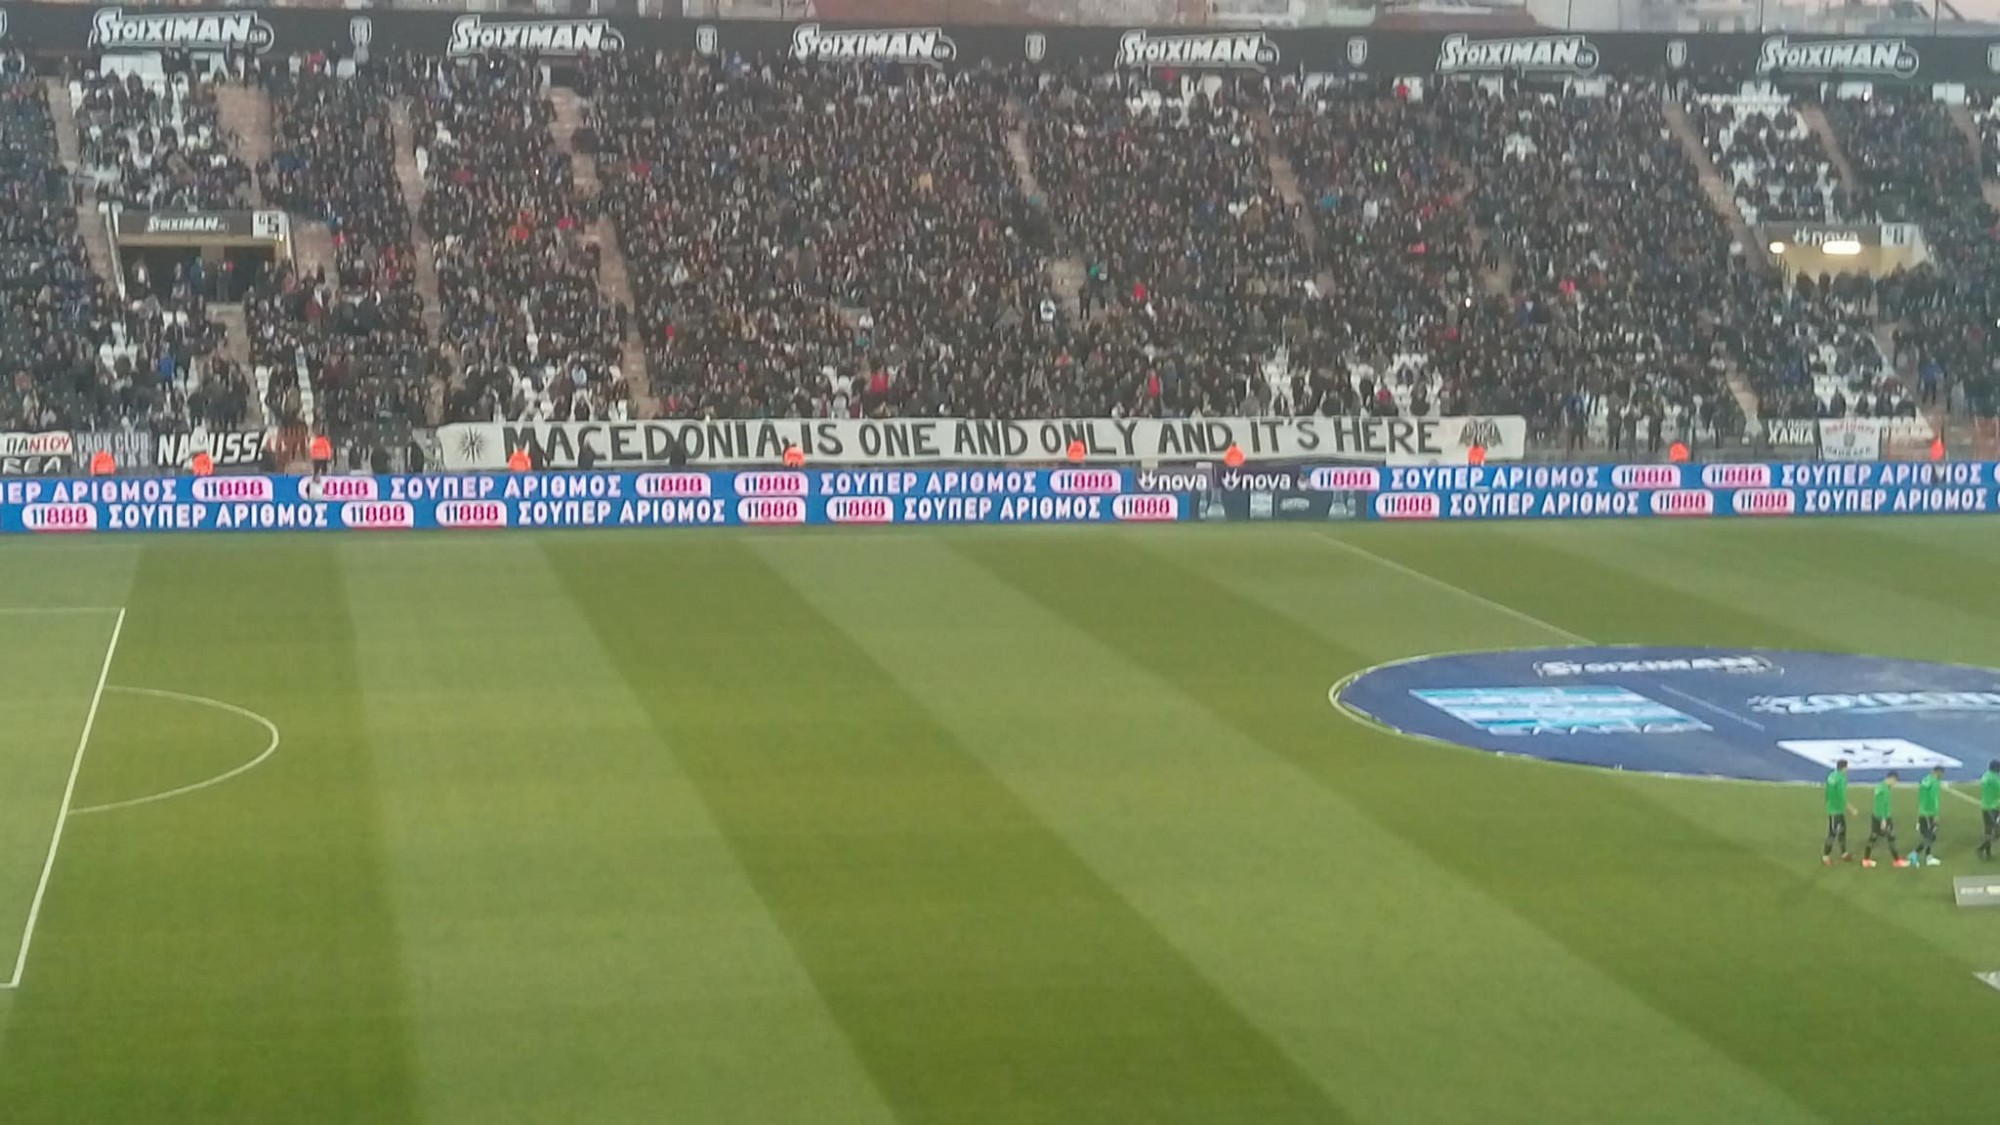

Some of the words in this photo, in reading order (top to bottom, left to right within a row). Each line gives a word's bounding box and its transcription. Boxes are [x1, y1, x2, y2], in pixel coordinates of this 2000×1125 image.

[502, 421, 782, 461] MACEDONIA
[801, 421, 843, 456] IS
[859, 422, 941, 457] ONE
[953, 419, 1029, 456] AND
[1040, 419, 1139, 455] ONLY
[1158, 419, 1234, 455] AND
[1250, 418, 1320, 454] IT'S
[1333, 416, 1443, 455] HERE
[391, 477, 494, 499] ΣΟΥΠΕΡ
[503, 474, 622, 498] ΑΡΙΘΜΟΣ
[644, 475, 702, 494] 11888
[744, 475, 803, 494] 11888
[820, 472, 918, 495] ΣΟΥΠΕΡ
[926, 471, 1036, 494] ΑΡΙΘΜΟΣ
[1059, 471, 1114, 489] 11888
[1158, 473, 1208, 491] nova
[1242, 473, 1291, 490] nova
[1320, 471, 1372, 488] 11888
[1391, 468, 1484, 488] ΣΟΥΠΕΡ
[1490, 466, 1599, 488] ΑΡΙΘΜΟΣ
[1620, 467, 1673, 484] 11888
[1711, 466, 1763, 483] 11888
[1781, 465, 1871, 487] ΣΟΥΠΕΡ
[52, 480, 177, 503] ΑΡΙΘΜΟΣ
[203, 478, 264, 498] 11888
[1741, 490, 1788, 508] 11888
[1804, 489, 1887, 512] ΣΟΥΠΕΡ
[1893, 488, 1987, 511] ΑΡΙΘΜΟΣ
[445, 504, 499, 522] 11888
[518, 502, 611, 524] ΣΟΥΠΕΡ
[618, 500, 726, 523] ΑΡΙΘΜΟΣ
[745, 501, 798, 518] 11888
[836, 500, 886, 518] 11888
[903, 498, 992, 521] ΣΟΥΠΕΡ
[1000, 497, 1102, 521] ΑΡΙΘΜΟΣ
[1122, 496, 1170, 514] 11888
[1383, 496, 1432, 513] 11888
[1450, 494, 1535, 515] ΣΟΥΠΕΡ
[1541, 491, 1639, 515] ΑΡΙΘΜΟΣ
[1659, 491, 1706, 509] 11888
[32, 506, 88, 525] 11888
[108, 505, 207, 528] ΣΟΥΠΕΡ
[215, 503, 328, 527] ΑΡΙΘΜΟΣ
[351, 506, 405, 524] 11888
